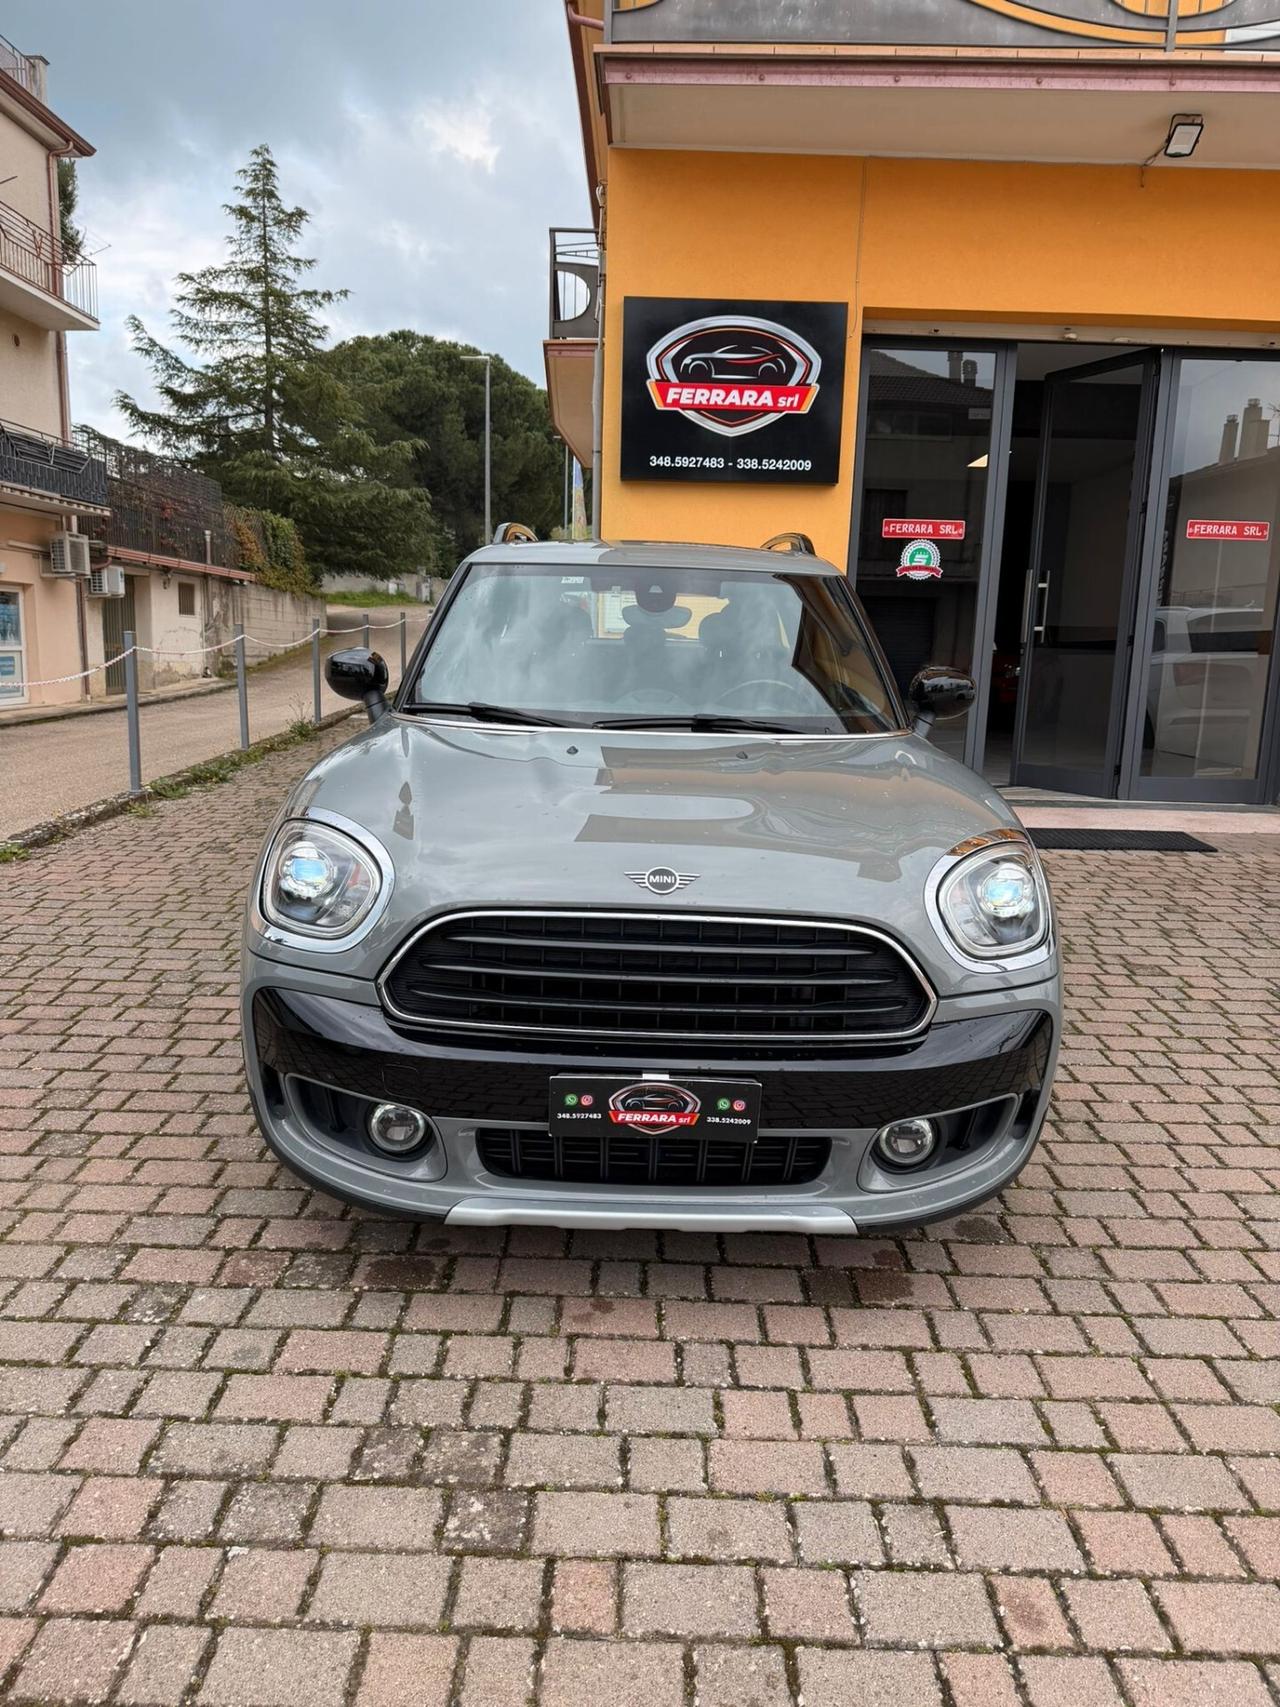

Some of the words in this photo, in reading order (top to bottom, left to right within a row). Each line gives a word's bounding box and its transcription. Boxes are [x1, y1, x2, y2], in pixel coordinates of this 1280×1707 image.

[666, 387, 773, 407] FERRARA
[777, 392, 800, 408] srl
[649, 456, 724, 469] 348.5927483
[736, 458, 812, 471] 338.5242009
[889, 523, 933, 534] FERRARA
[939, 524, 958, 535] SRL
[1194, 524, 1237, 535] FERRARA
[1243, 526, 1262, 536] SRL
[649, 875, 675, 884] MINI
[617, 1113, 676, 1123] FERRARA
[678, 1115, 690, 1124] srl
[706, 1116, 752, 1125] 338.5242009
